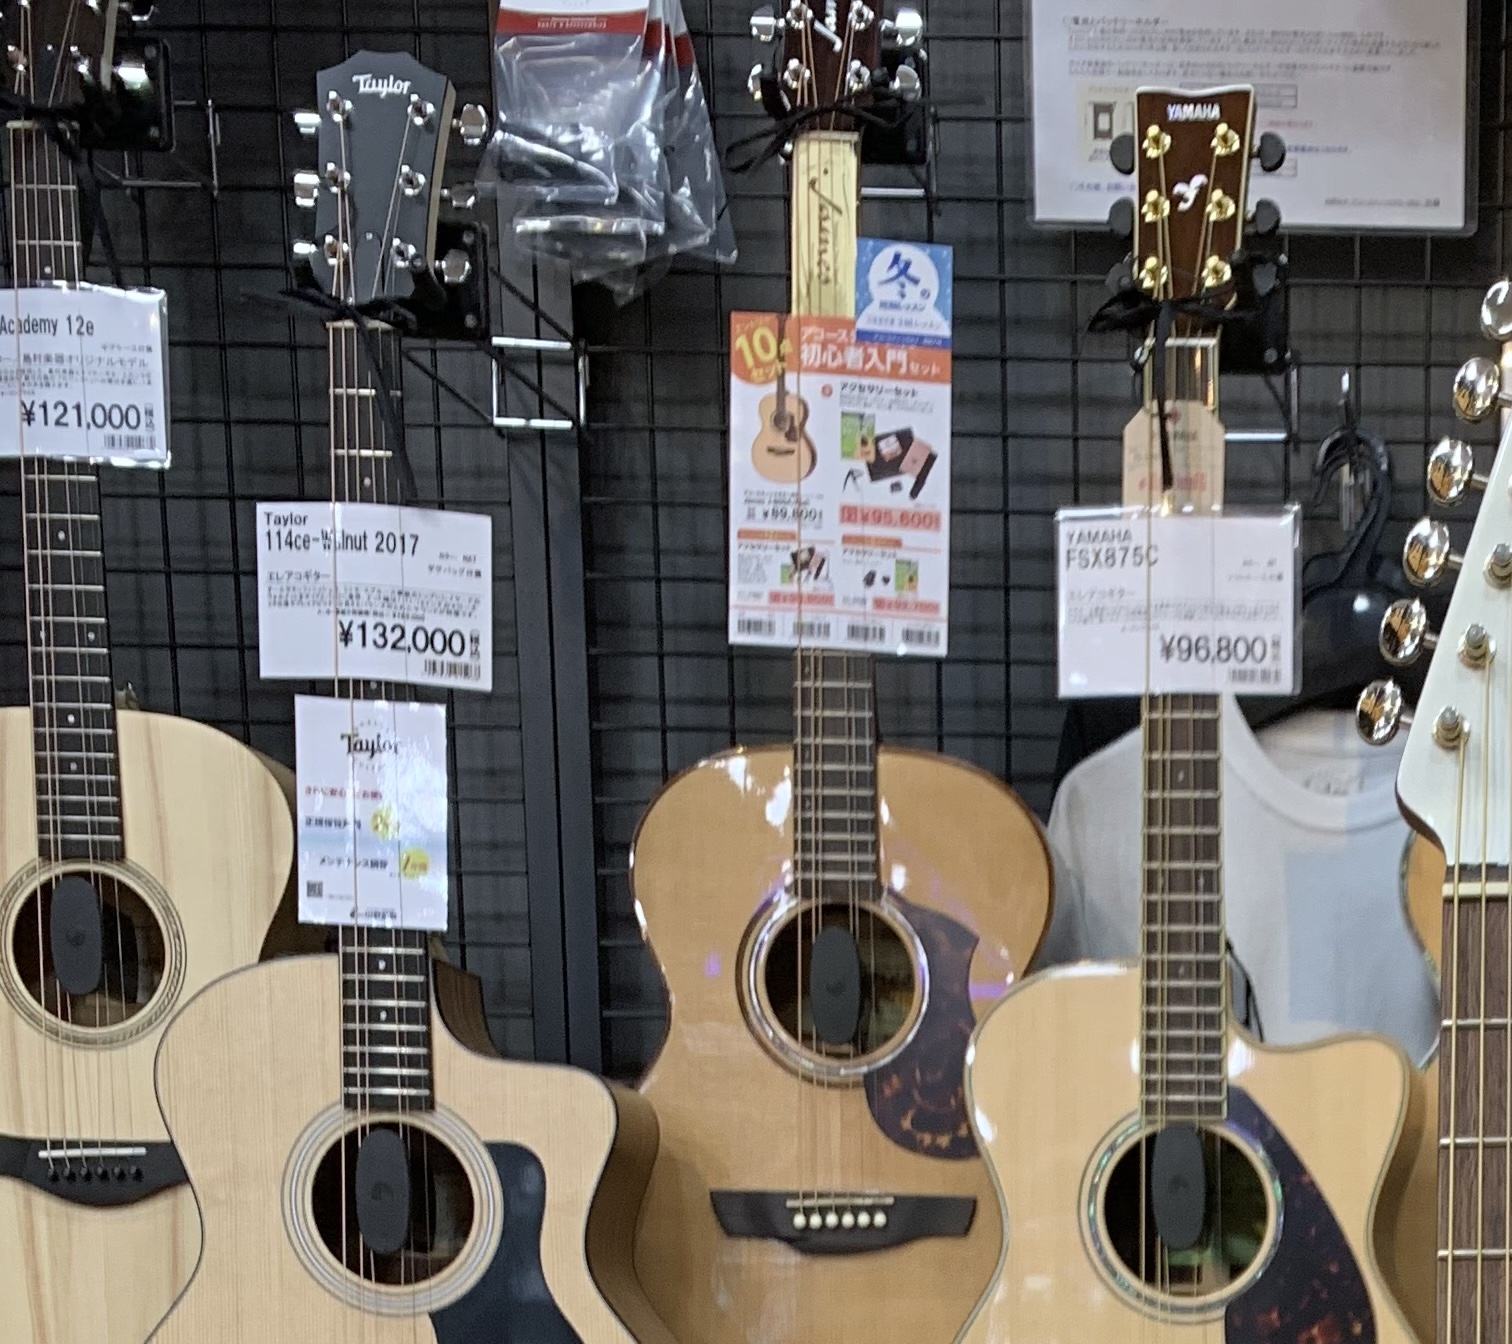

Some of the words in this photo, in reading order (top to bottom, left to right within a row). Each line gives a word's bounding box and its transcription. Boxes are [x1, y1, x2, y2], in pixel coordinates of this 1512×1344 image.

[351, 74, 411, 99] Taylor
[1167, 103, 1220, 121] YAMAHA
[878, 251, 921, 299] 冬
[0, 314, 58, 337] Academy
[66, 315, 95, 336] 12e
[801, 343, 908, 374] 初心者入門
[21, 400, 141, 430] ¥121,000
[264, 512, 308, 526] Taylor
[265, 529, 368, 551] 114ce-Wlnut
[375, 531, 419, 556] 2017
[1067, 529, 1132, 545] YAMAHA
[1065, 544, 1159, 570] FSX875C
[339, 620, 466, 657] ¥132,000
[1160, 633, 1267, 663] ¥96,800
[340, 733, 400, 759] Taylor
